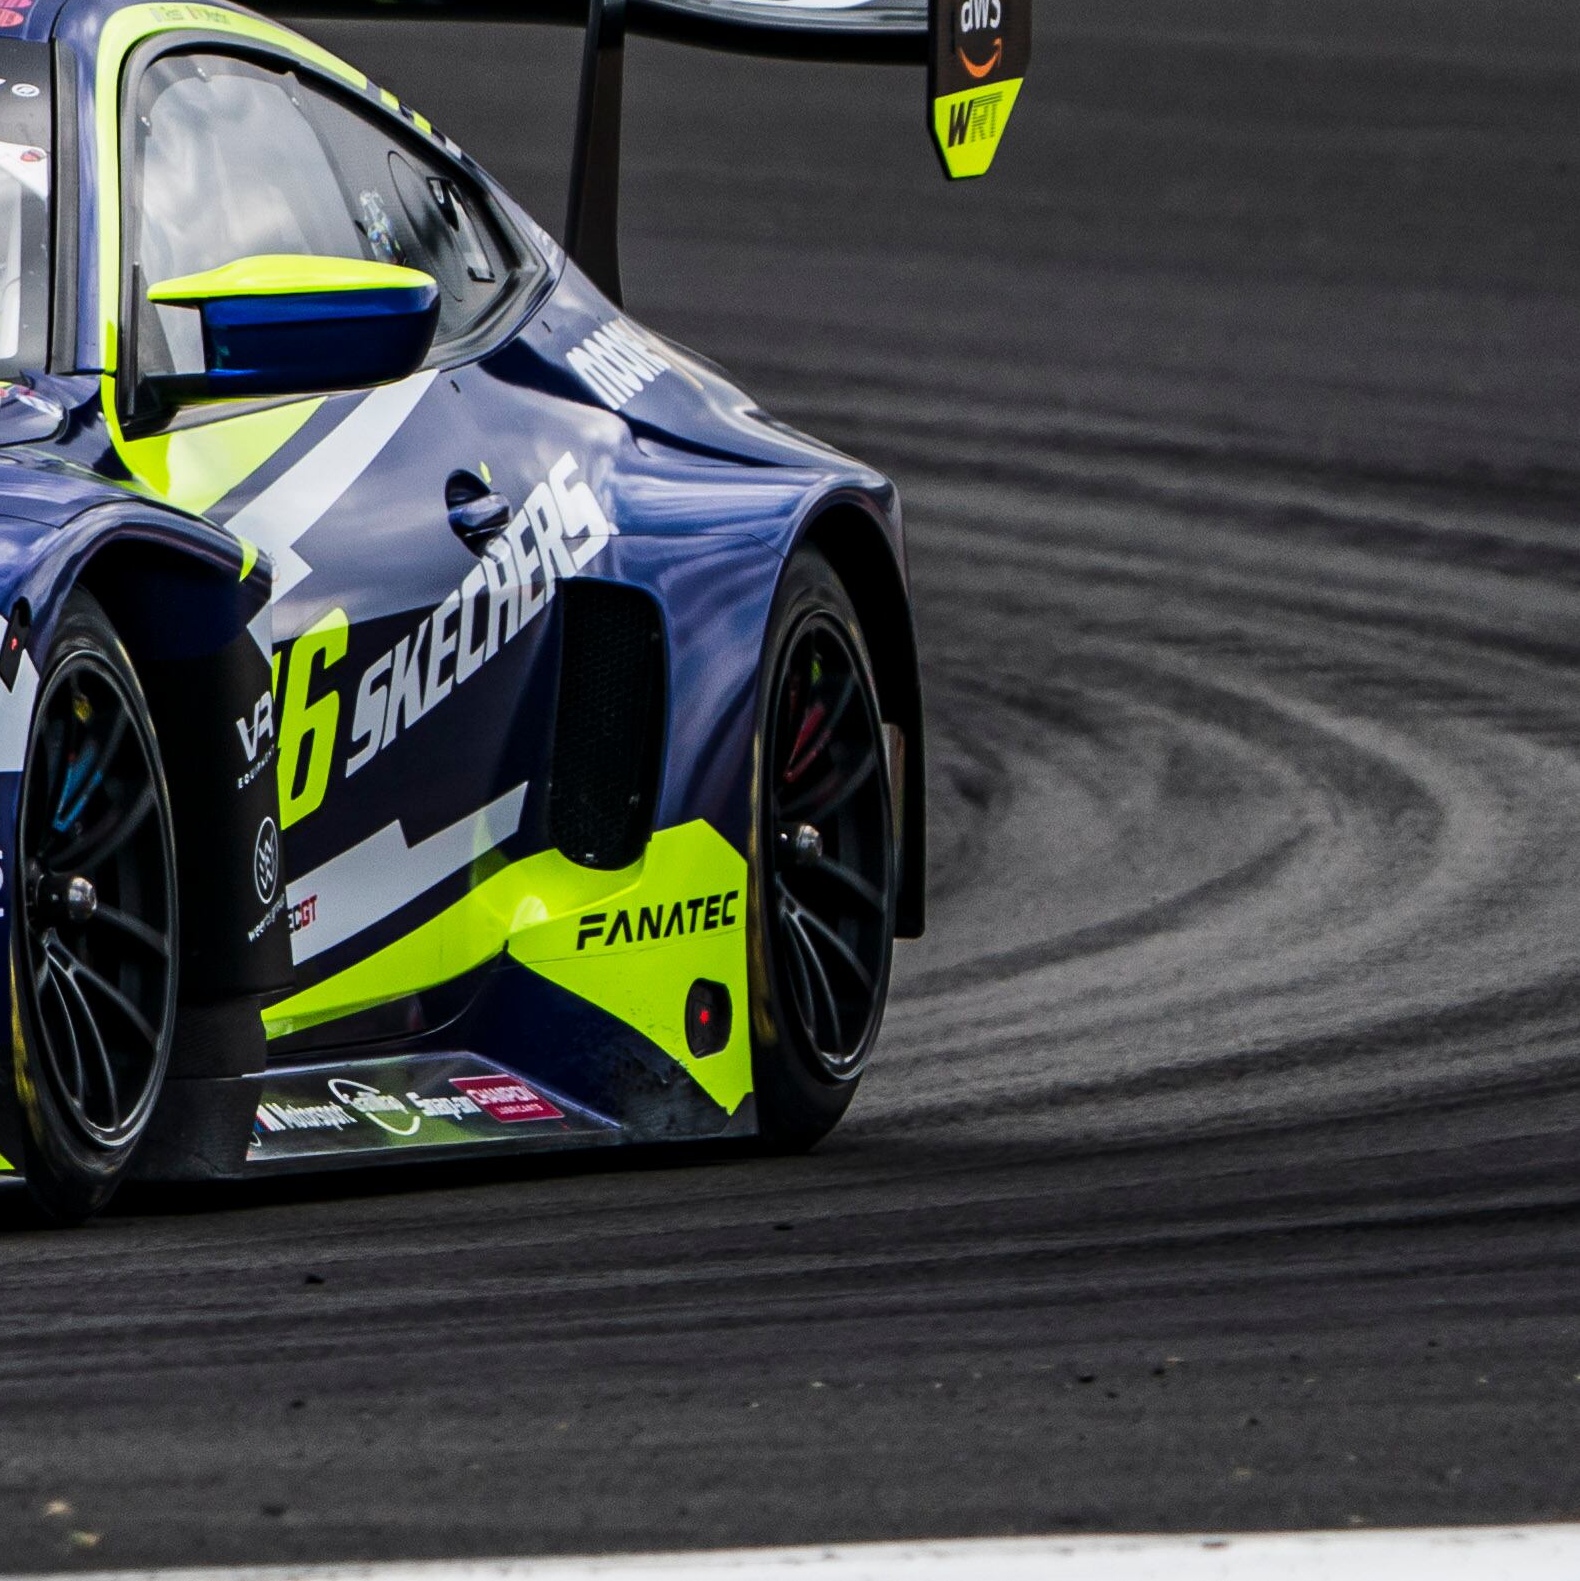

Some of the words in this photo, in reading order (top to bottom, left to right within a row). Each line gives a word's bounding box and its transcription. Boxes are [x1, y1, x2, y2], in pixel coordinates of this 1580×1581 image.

[271, 607, 349, 831] 6
[346, 451, 610, 778] SKECHERS
[576, 890, 739, 952] FANATEC
